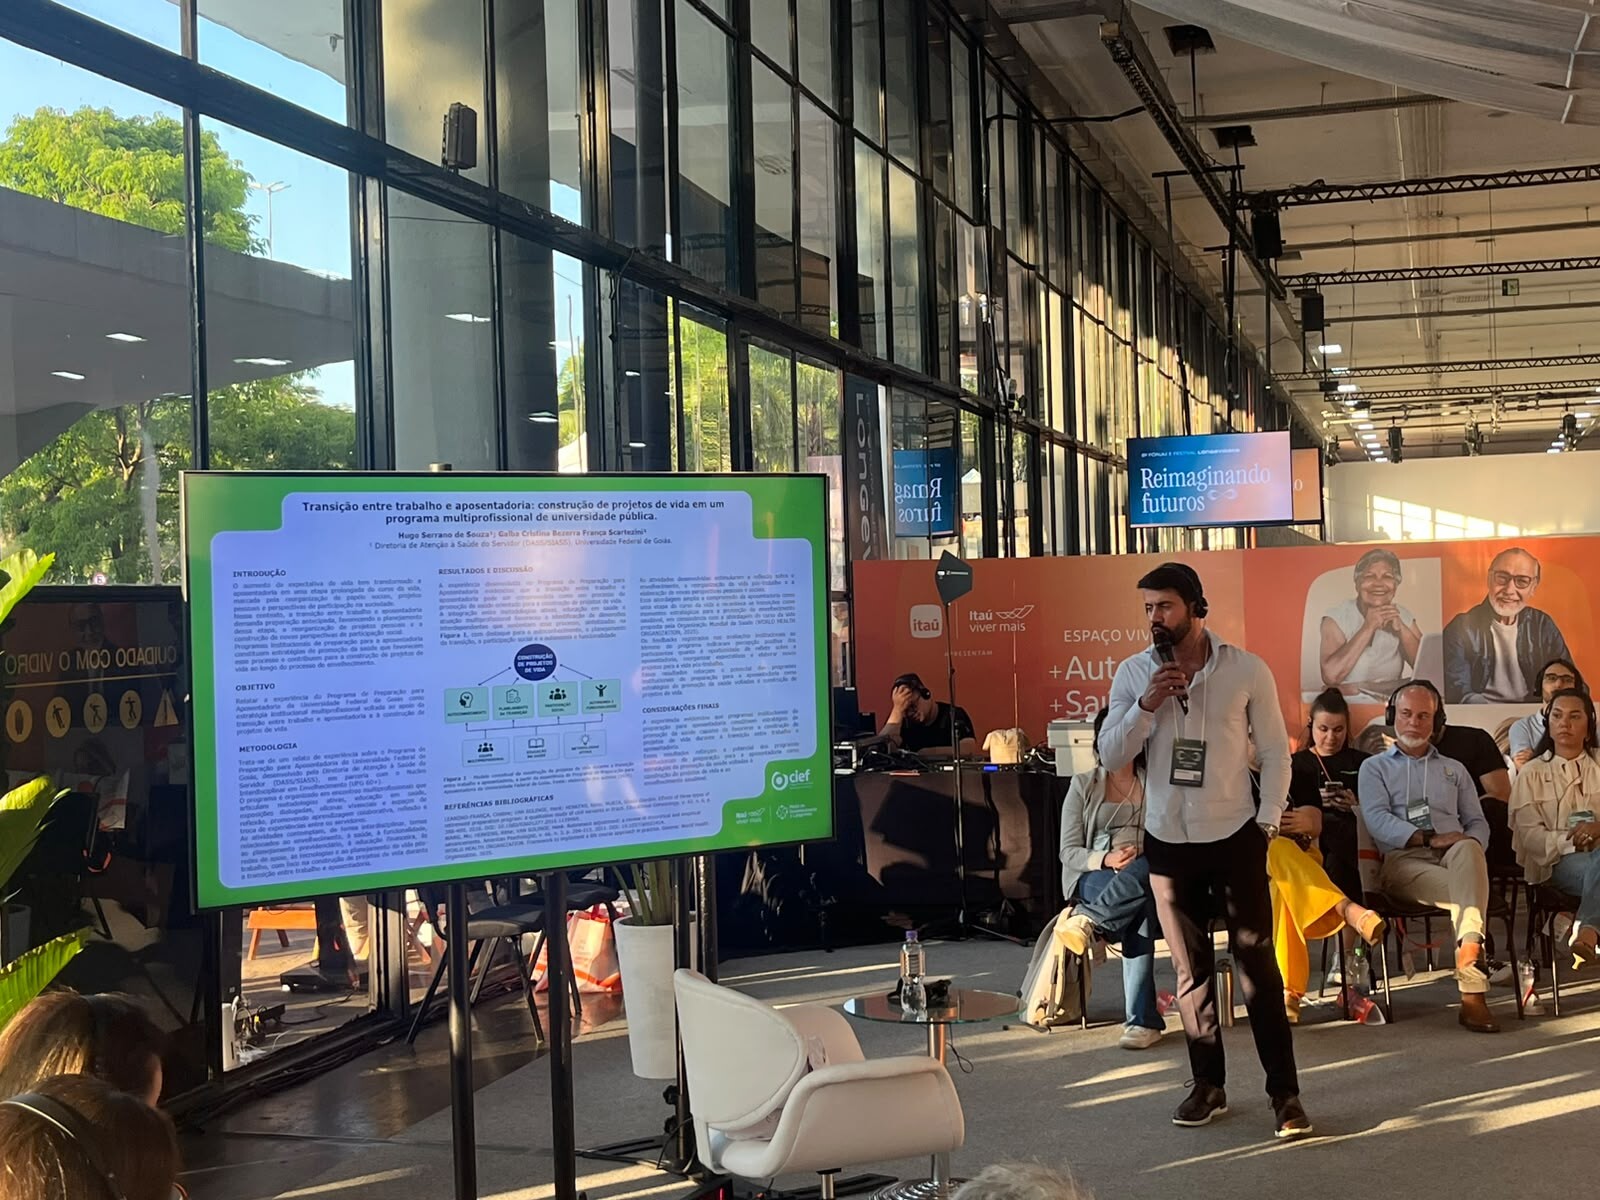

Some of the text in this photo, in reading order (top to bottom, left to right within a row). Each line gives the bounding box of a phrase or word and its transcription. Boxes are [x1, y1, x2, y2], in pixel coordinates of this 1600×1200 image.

[1140, 463, 1271, 492] Reimaginando
[302, 502, 359, 513] Transição
[361, 502, 392, 510] entre
[395, 501, 442, 510] trabalho
[454, 501, 534, 512] aposentadoria:
[537, 501, 594, 511] construção
[596, 501, 609, 509] de
[611, 501, 653, 511] projetos
[1142, 493, 1205, 514] futuros
[385, 512, 658, 524] programa multiprofissional de universidade pública.
[397, 531, 419, 540] Hugo
[582, 529, 606, 537] França
[232, 568, 286, 578] INTRODUÇÃO
[969, 609, 993, 621] Itaú
[913, 618, 940, 632] itaú
[969, 621, 1026, 633] viver mais
[1064, 629, 1152, 644] ESPAÇO VIV
[234, 682, 275, 691] OBJETIVO
[642, 703, 695, 714] CONSIDERAÇÕES
[238, 742, 297, 752] METODOLOGIA
[443, 793, 554, 810] REFERÊNCIAS BIBLIOGRÁFICAS
